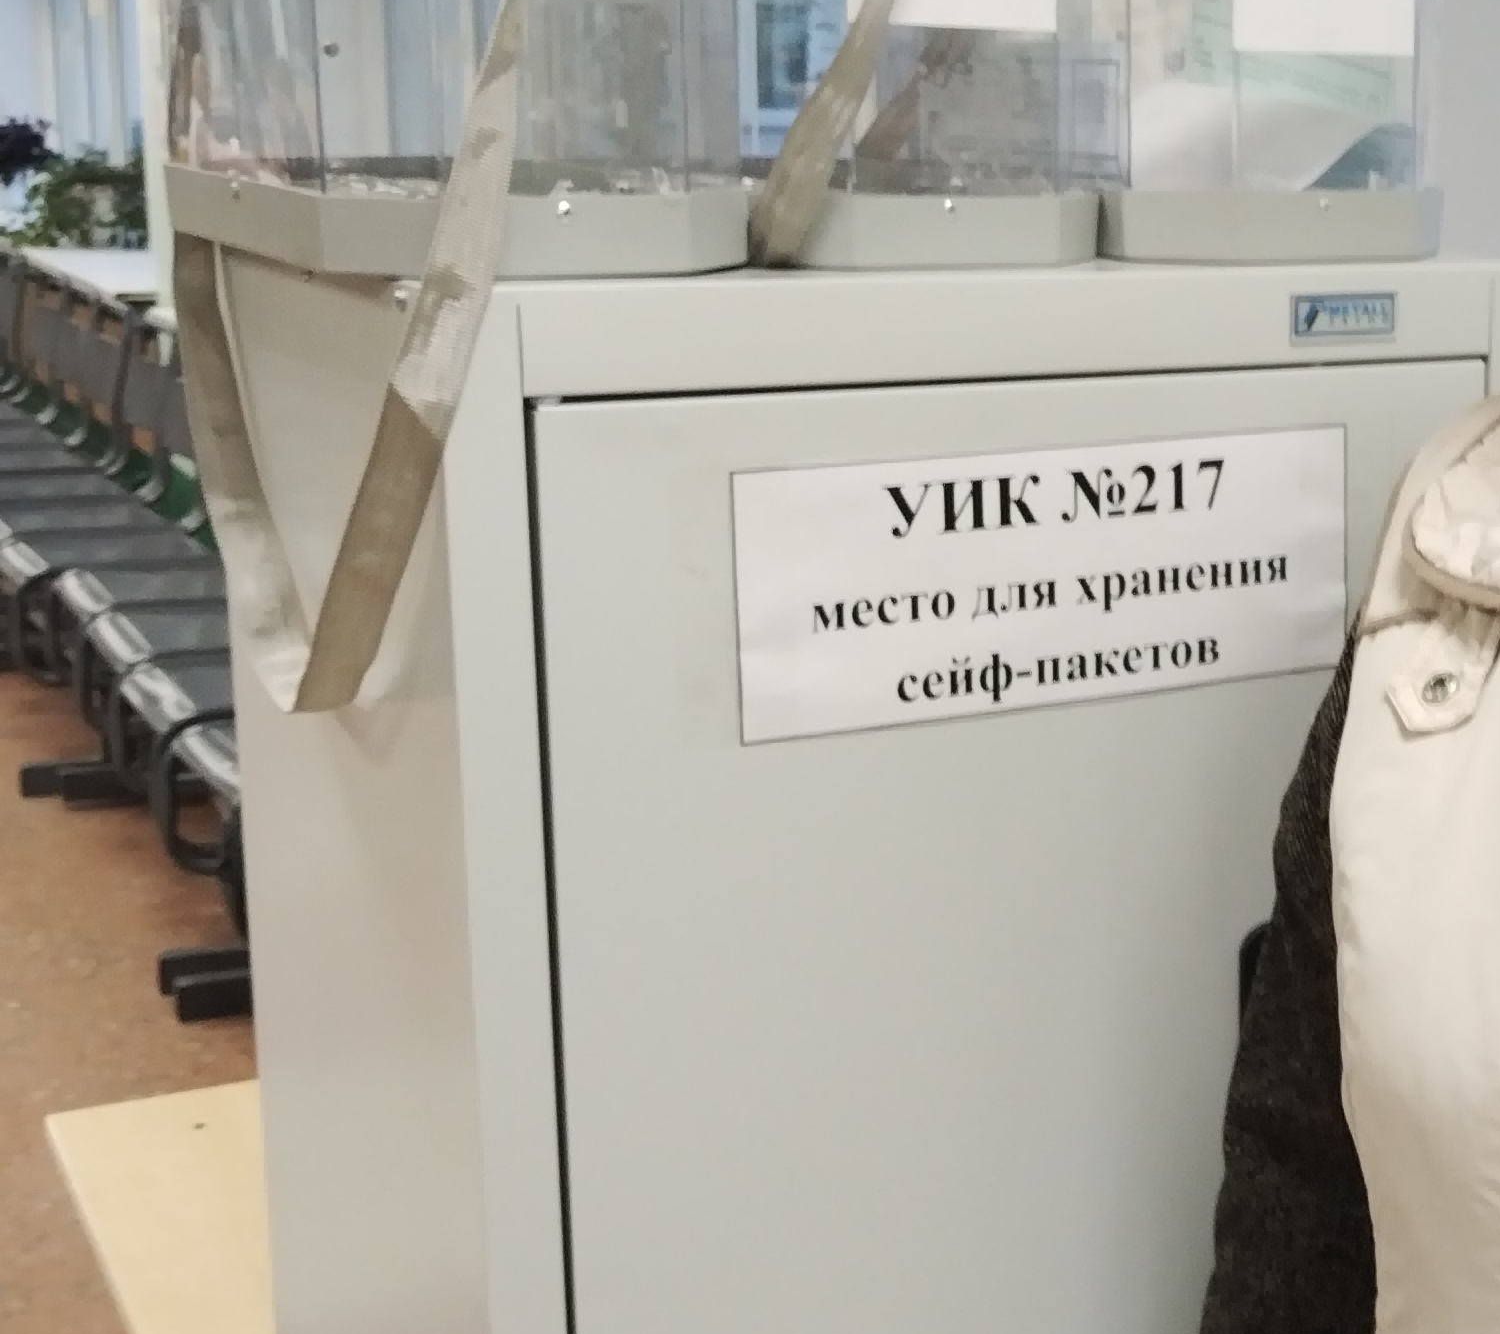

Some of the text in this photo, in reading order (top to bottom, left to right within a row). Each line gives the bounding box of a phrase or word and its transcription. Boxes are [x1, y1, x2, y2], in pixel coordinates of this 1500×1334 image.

[884, 458, 1225, 539] УИК №217
[811, 554, 1289, 634] место для хранения
[896, 636, 1220, 703] сейф-пакетов
